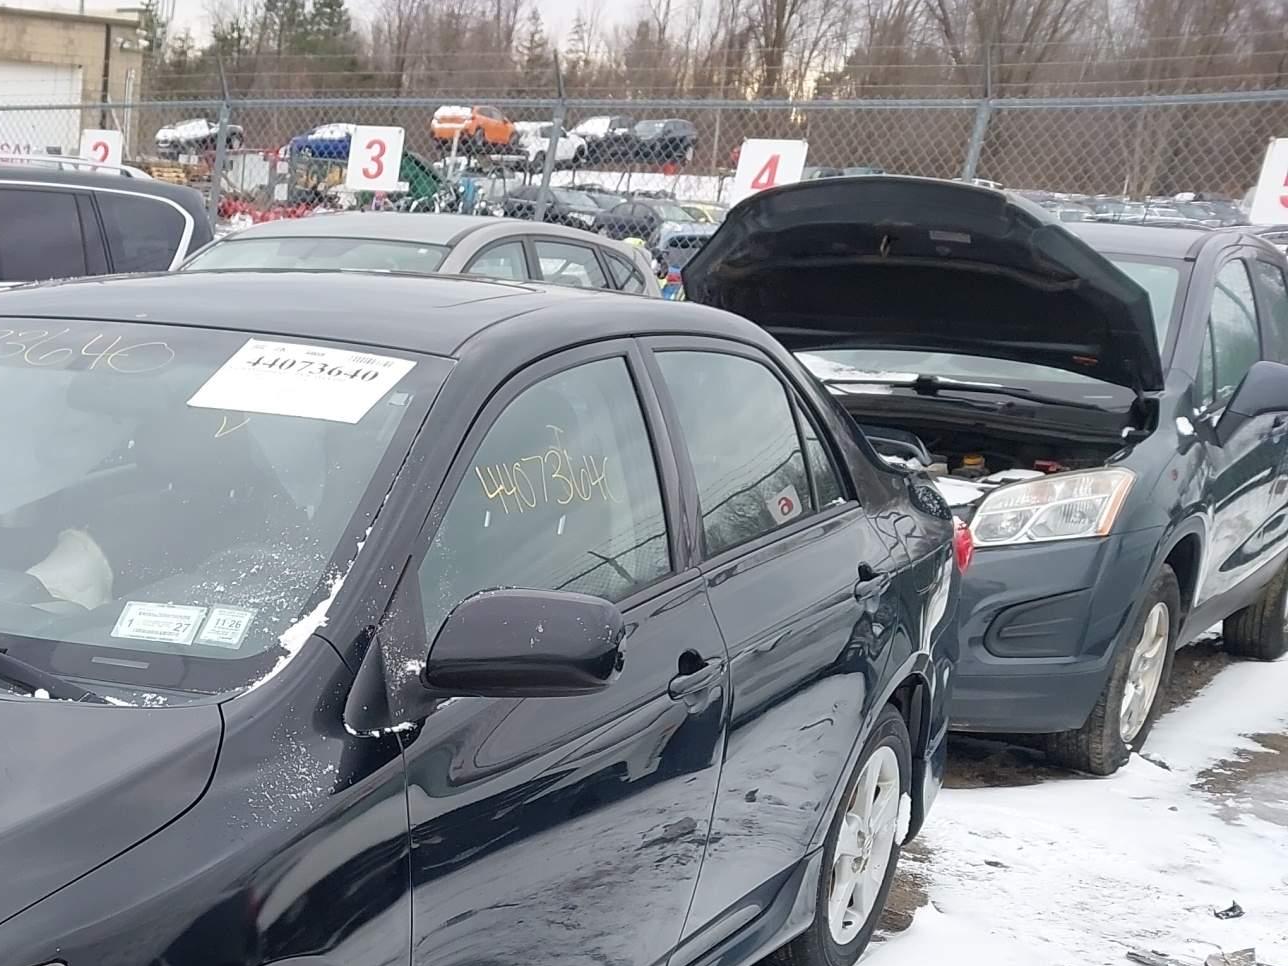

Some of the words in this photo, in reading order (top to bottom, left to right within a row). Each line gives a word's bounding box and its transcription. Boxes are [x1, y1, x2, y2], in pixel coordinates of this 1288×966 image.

[91, 141, 110, 170] 2
[362, 138, 386, 180] 3
[750, 154, 781, 190] 4
[246, 354, 380, 383] 44073640
[173, 622, 191, 634] 27
